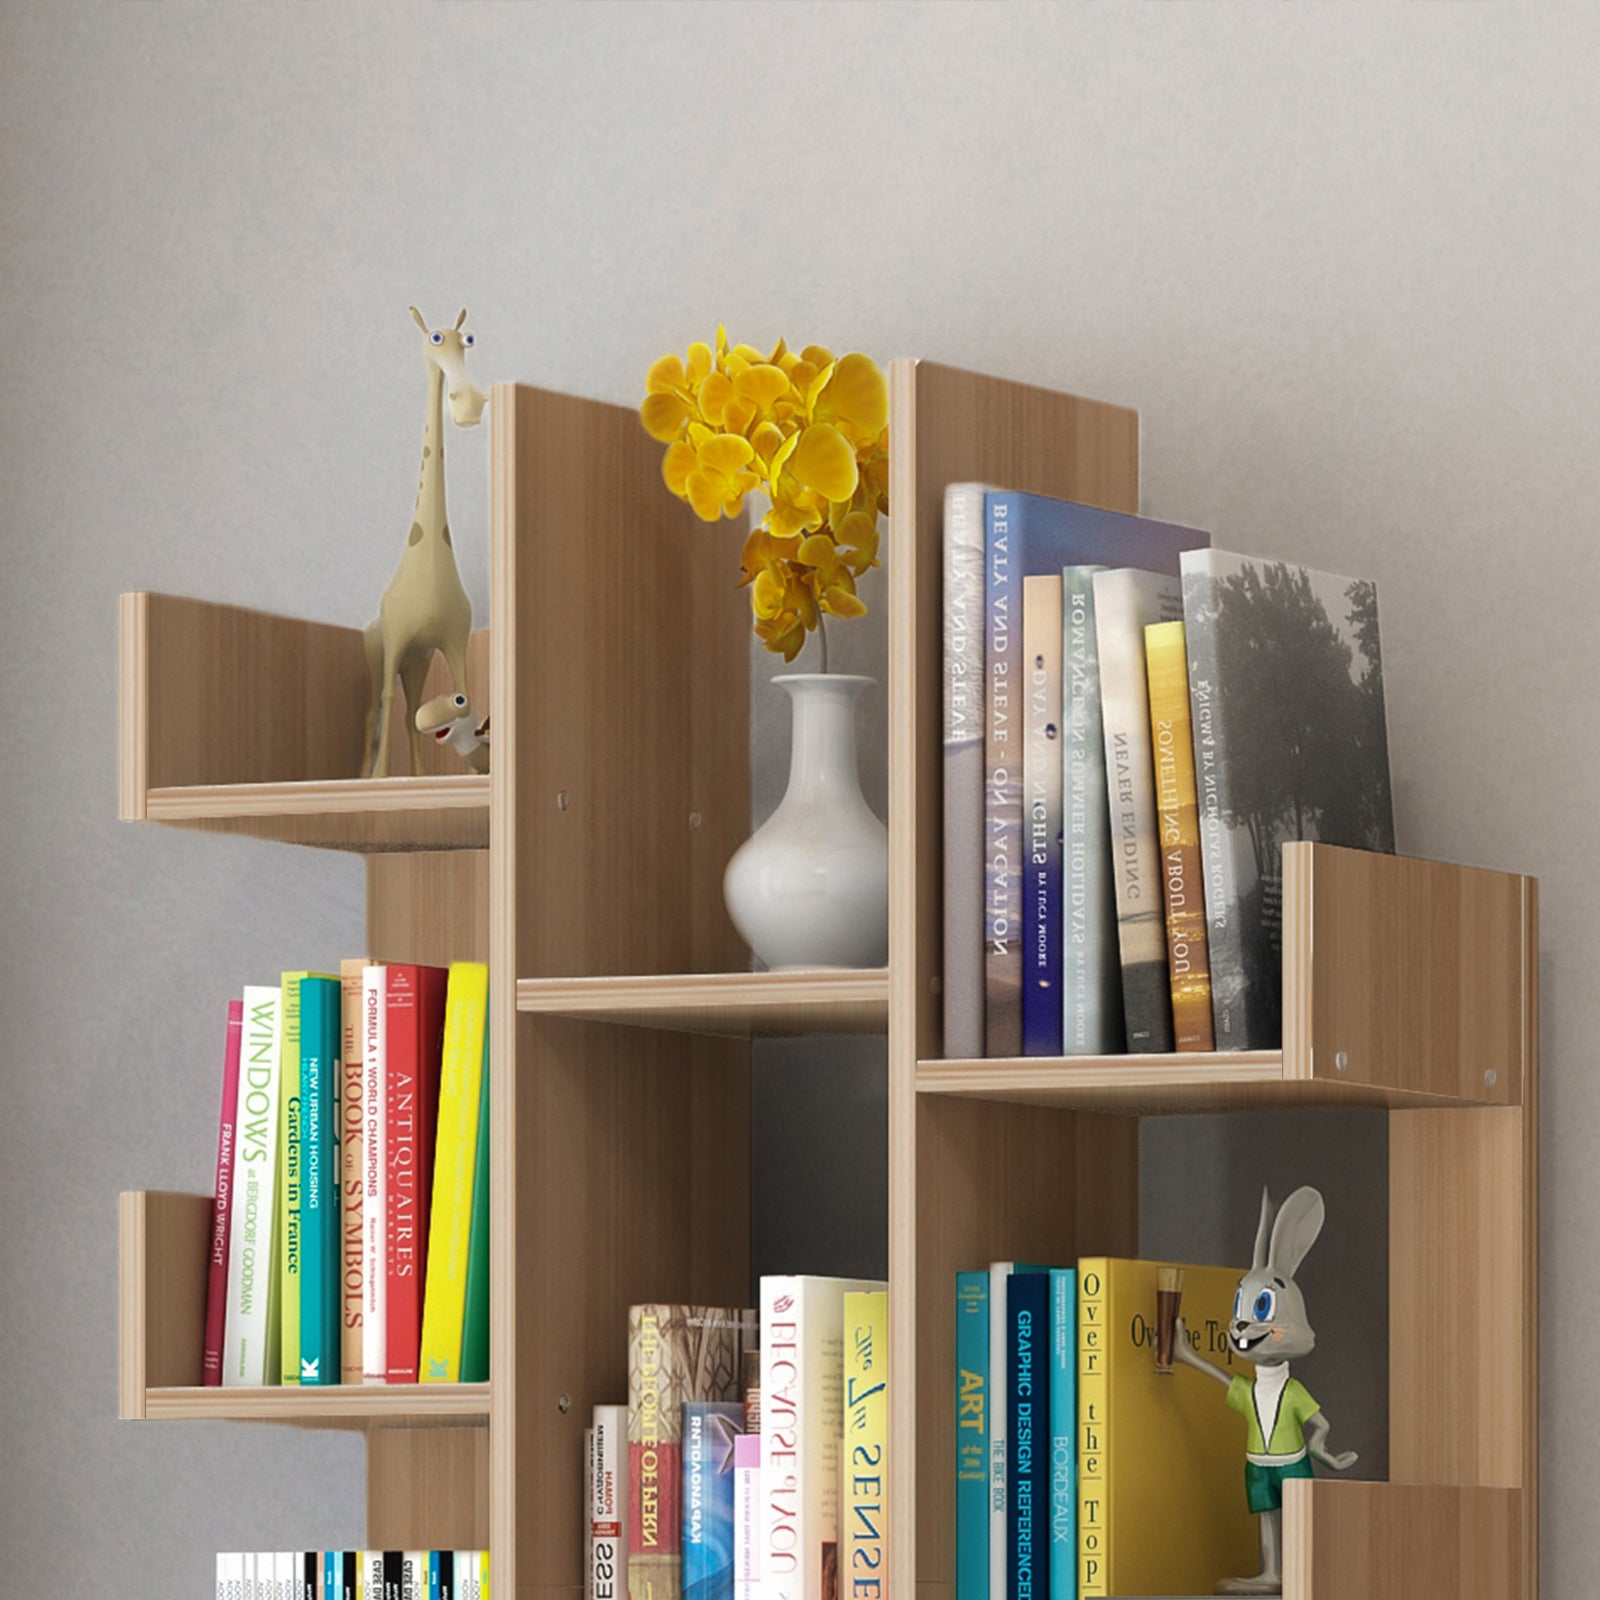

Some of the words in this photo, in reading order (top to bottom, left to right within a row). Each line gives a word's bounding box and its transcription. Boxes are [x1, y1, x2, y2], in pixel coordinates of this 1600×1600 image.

[345, 1024, 354, 1054] THE
[367, 988, 378, 1053] FORMULA
[242, 1001, 275, 1163] WINDOWS
[309, 1057, 318, 1090] NEW
[344, 1061, 363, 1147] BOOK
[367, 1066, 377, 1115] WORLD
[219, 1122, 232, 1167] FRANK
[287, 1096, 301, 1178] Gardens
[309, 1092, 318, 1141] URBAN
[216, 1168, 229, 1211] LLOYD
[309, 1144, 318, 1209] HOUSING
[367, 1119, 377, 1198] CHAMPIONS
[392, 1071, 413, 1277] ANTIQUAIRES
[243, 1181, 258, 1246] BERGDORF
[288, 1183, 301, 1202] in
[213, 1213, 226, 1266] WRIGHT
[288, 1209, 301, 1275] France
[344, 1179, 363, 1329] SYMBOLS
[240, 1248, 256, 1316] GOODMAN
[1017, 1310, 1032, 1397] GRAPHIC
[1083, 1272, 1100, 1371] Over
[960, 1369, 984, 1434] ART
[993, 1438, 1005, 1458] THE
[1017, 1403, 1032, 1474] DESIGN
[1084, 1402, 1100, 1474] the
[1053, 1436, 1069, 1543] BORDEAUX
[1084, 1500, 1100, 1583] Top
